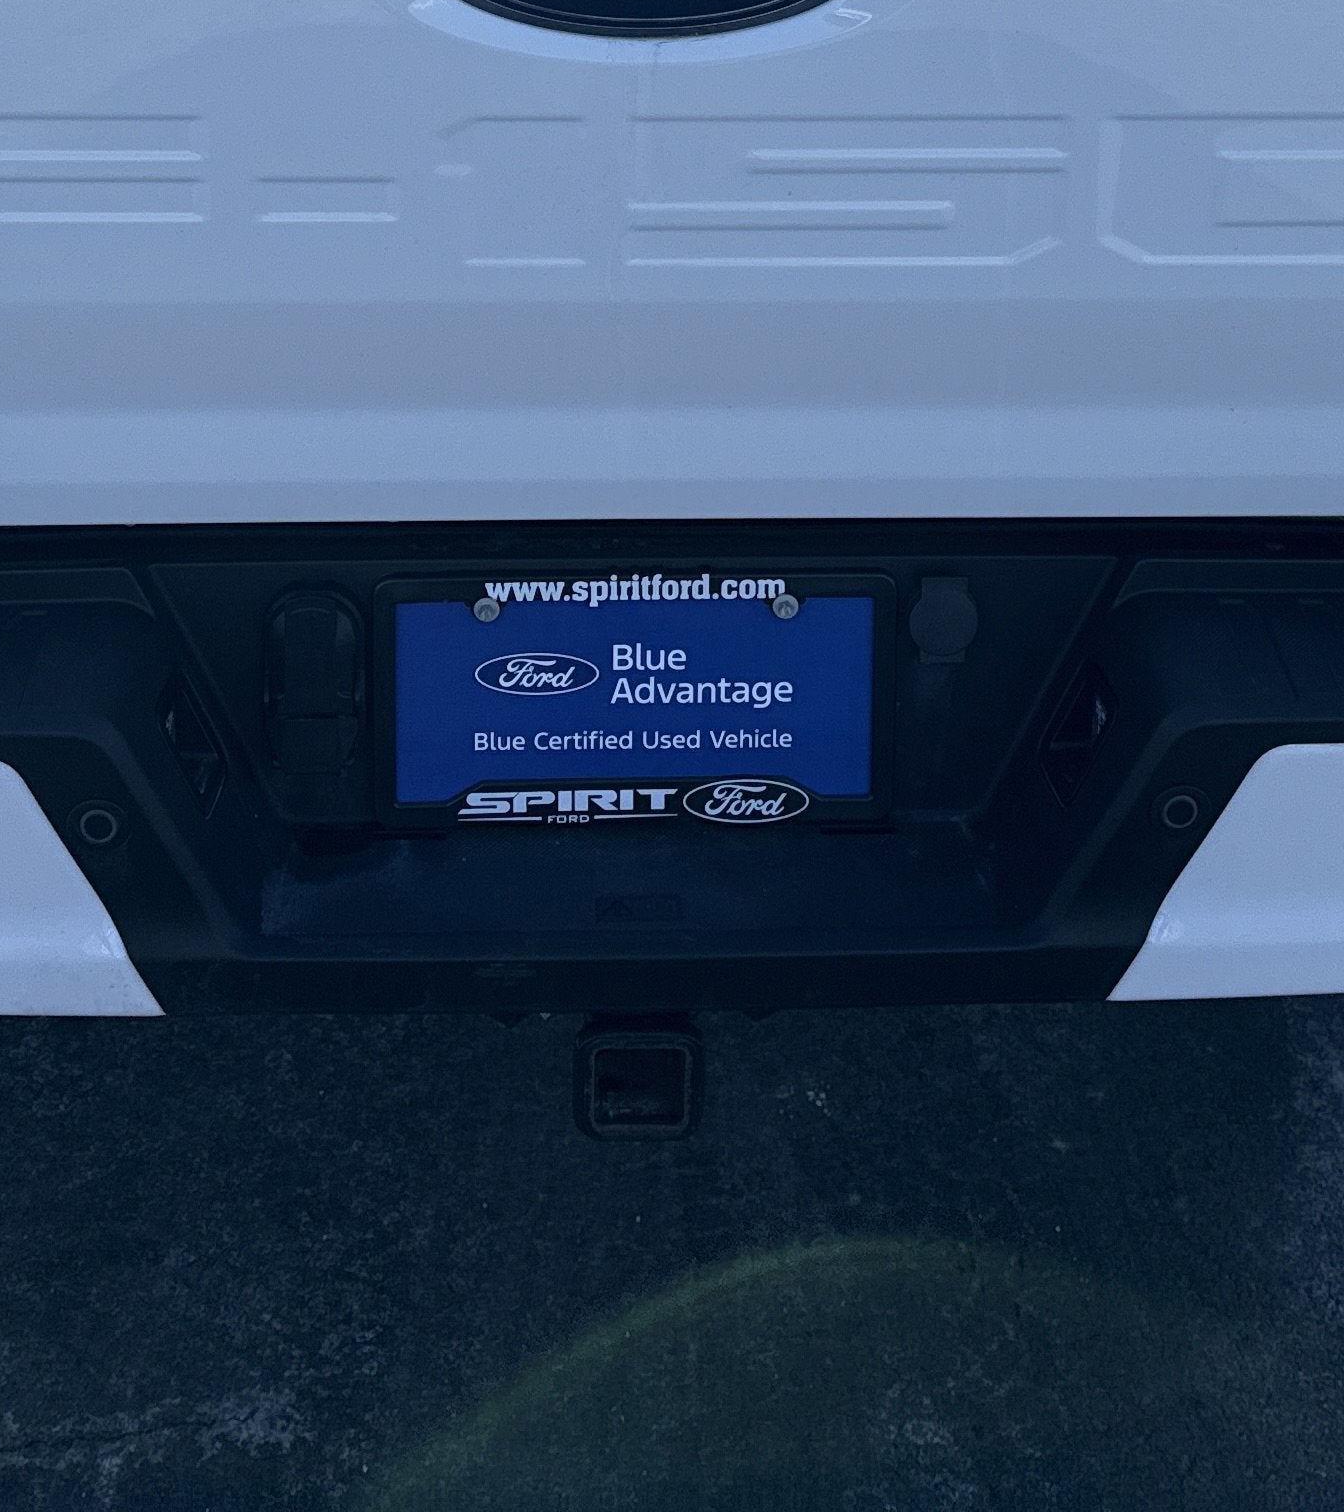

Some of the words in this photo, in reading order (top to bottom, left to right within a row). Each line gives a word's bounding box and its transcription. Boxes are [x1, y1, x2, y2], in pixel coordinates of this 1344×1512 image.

[485, 573, 786, 607] www.spiritford.com
[612, 642, 687, 671] Blue
[498, 658, 576, 690] Ford
[610, 676, 794, 709] Advantage
[474, 731, 526, 752] Blue
[534, 730, 634, 751] Certified
[642, 729, 701, 750] Used
[709, 728, 793, 749] Vehicle
[458, 788, 678, 816] SPIRIT
[704, 784, 787, 817] Ford
[547, 814, 590, 824] FORD
